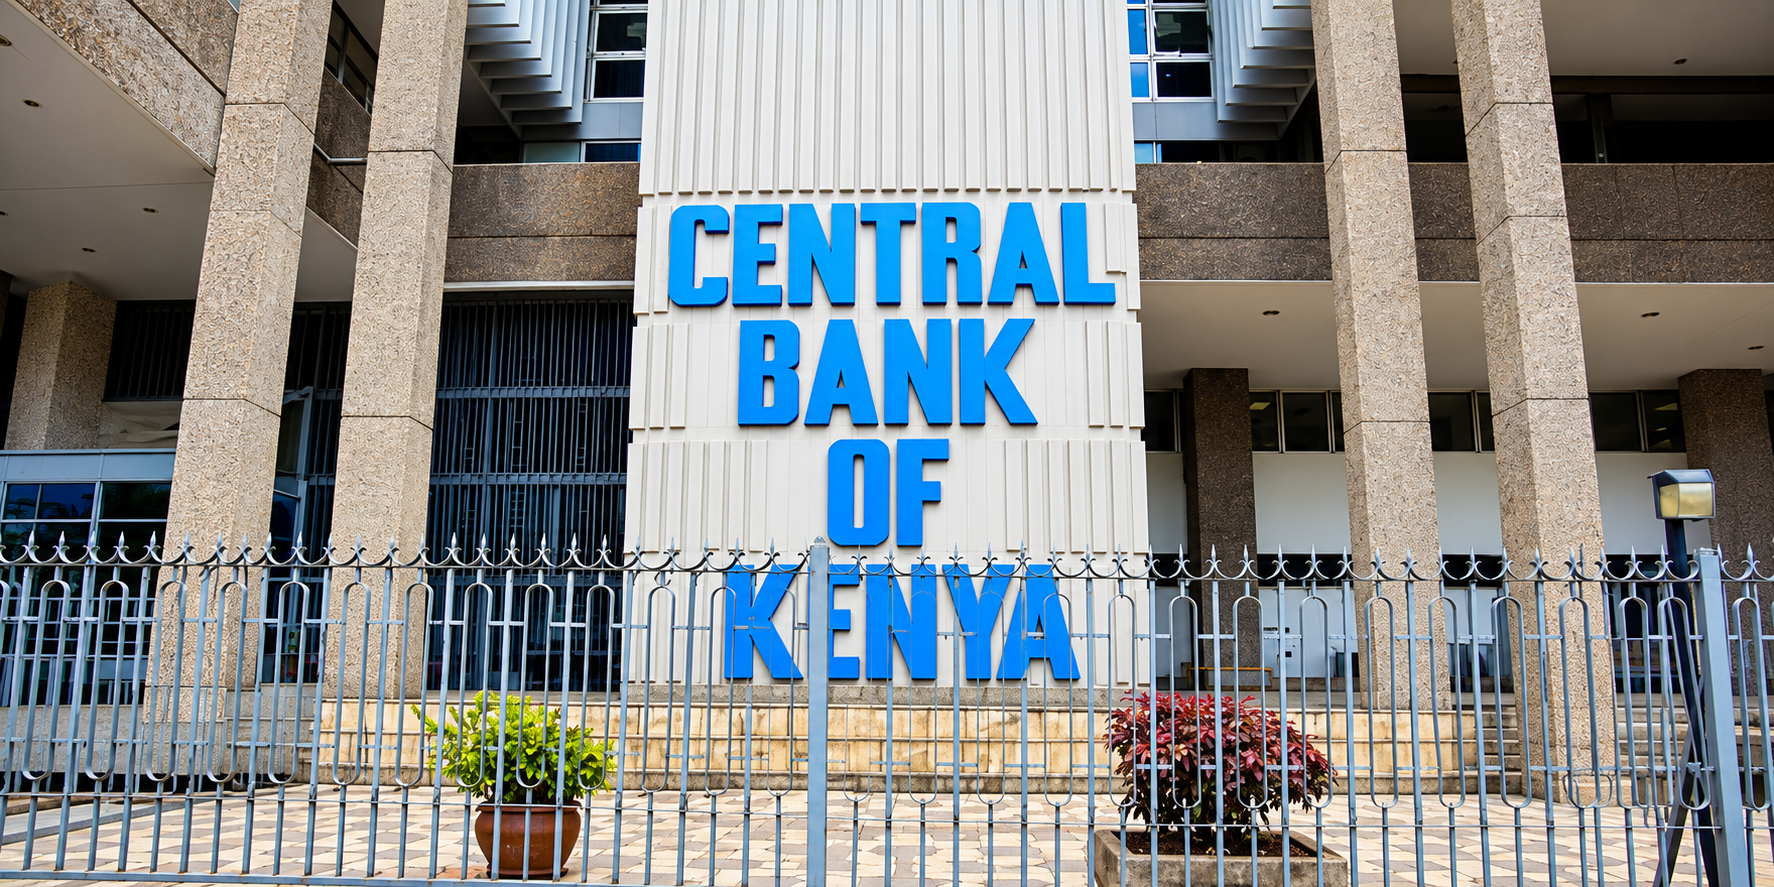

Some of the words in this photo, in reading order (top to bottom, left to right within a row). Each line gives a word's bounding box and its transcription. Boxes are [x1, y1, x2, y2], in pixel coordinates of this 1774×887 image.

[668, 202, 1116, 306] CENTRAL
[737, 318, 1038, 425] BANK
[827, 438, 949, 546] OF
[724, 563, 1080, 680] KENYA
